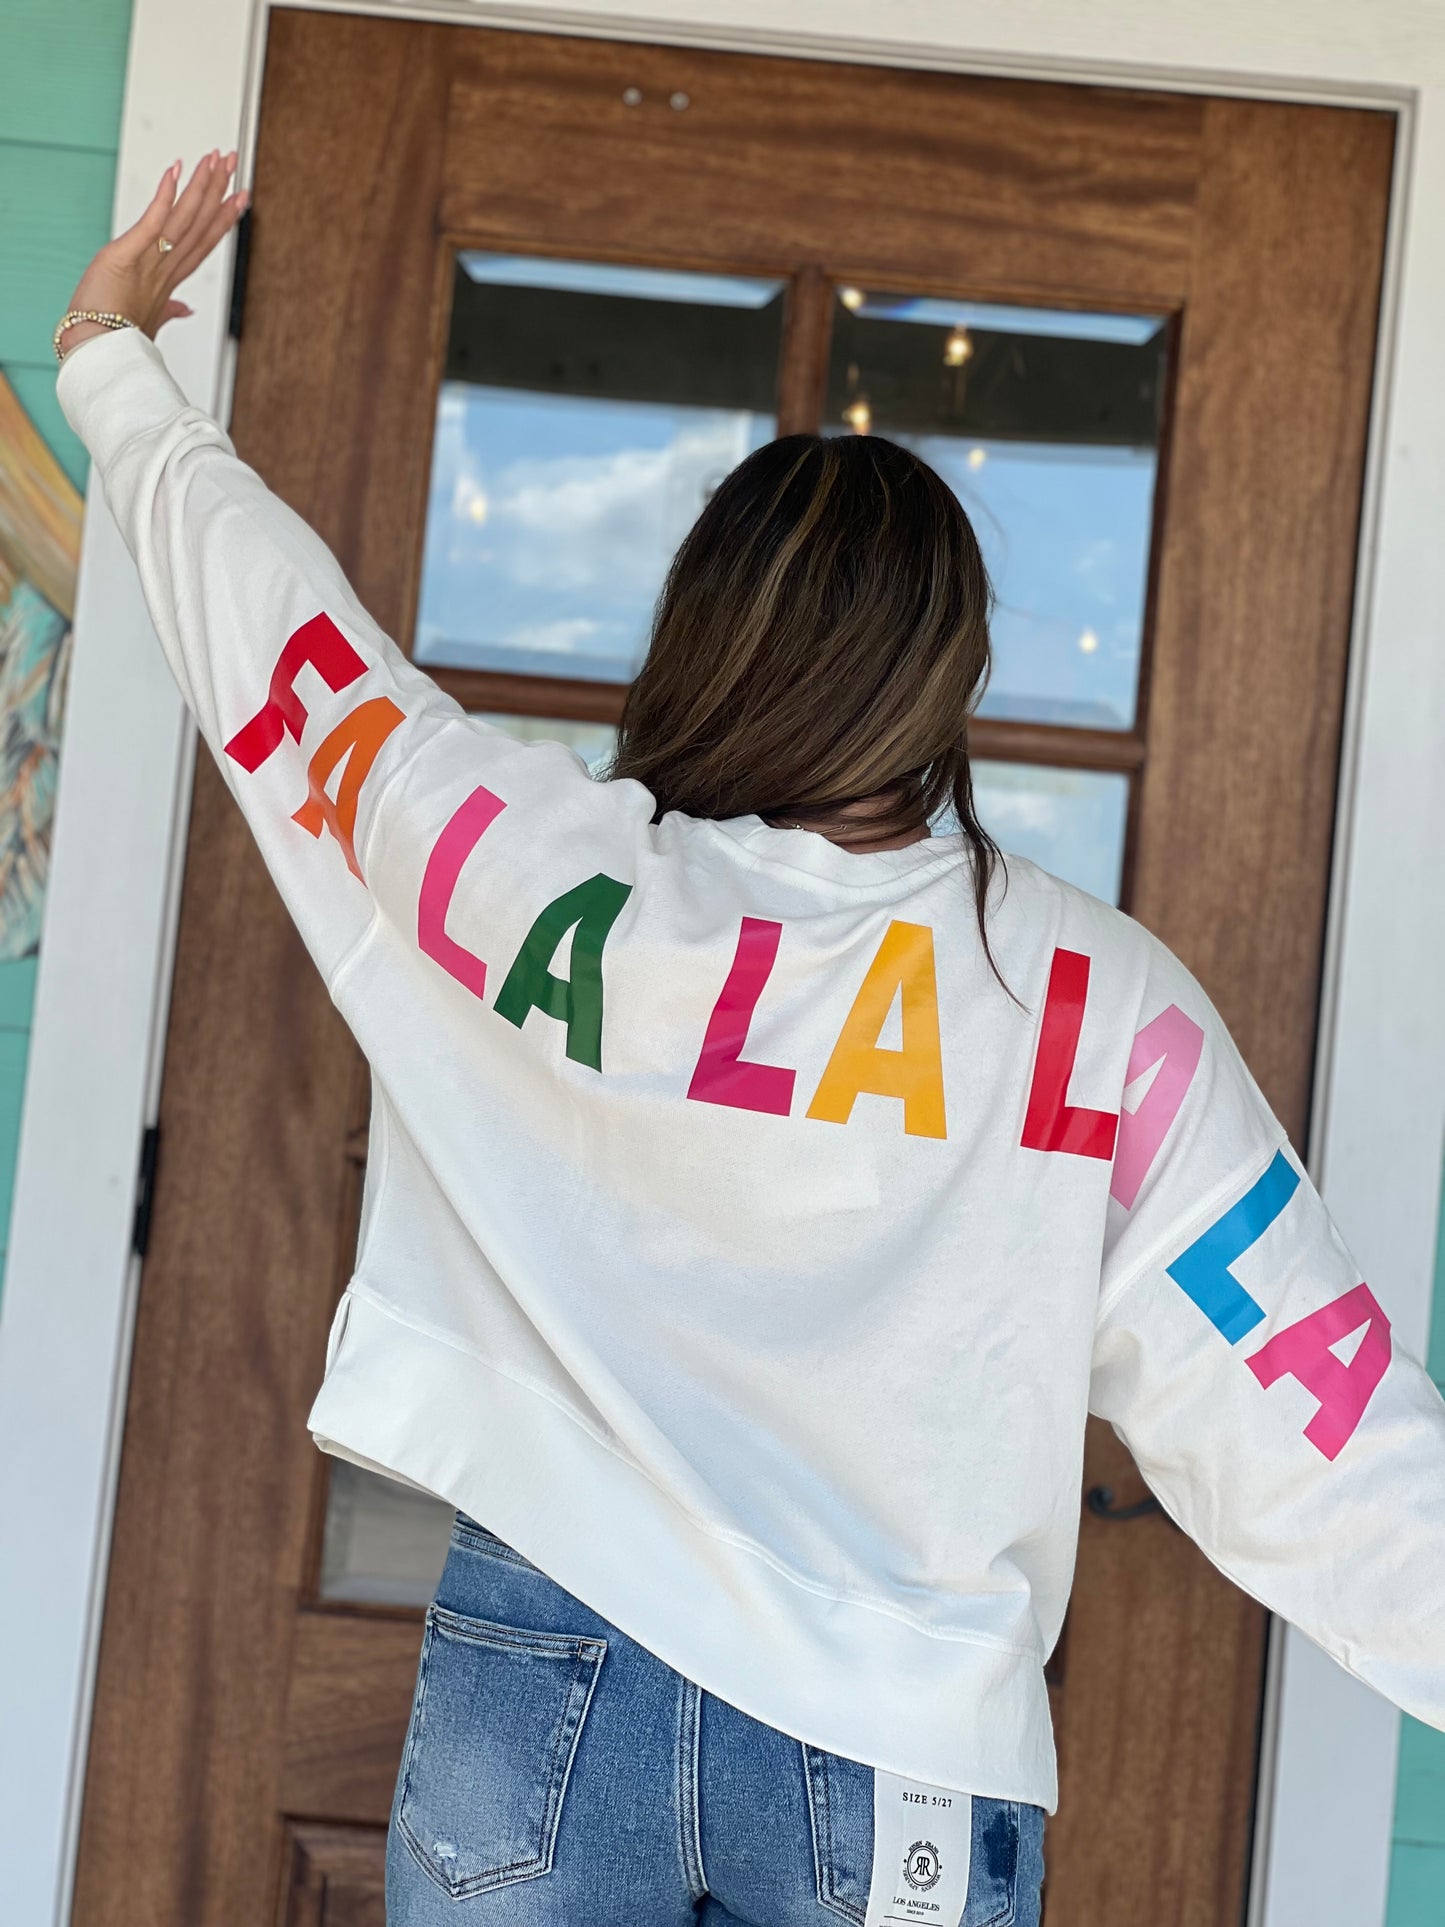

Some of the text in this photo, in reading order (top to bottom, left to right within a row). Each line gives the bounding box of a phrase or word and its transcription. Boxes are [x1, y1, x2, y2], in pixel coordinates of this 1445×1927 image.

[223, 611, 1392, 1462] FA LA LA LA LA
[902, 1791, 952, 1807] SIZE 5/27
[892, 1896, 940, 1911] LOS ANGELES
